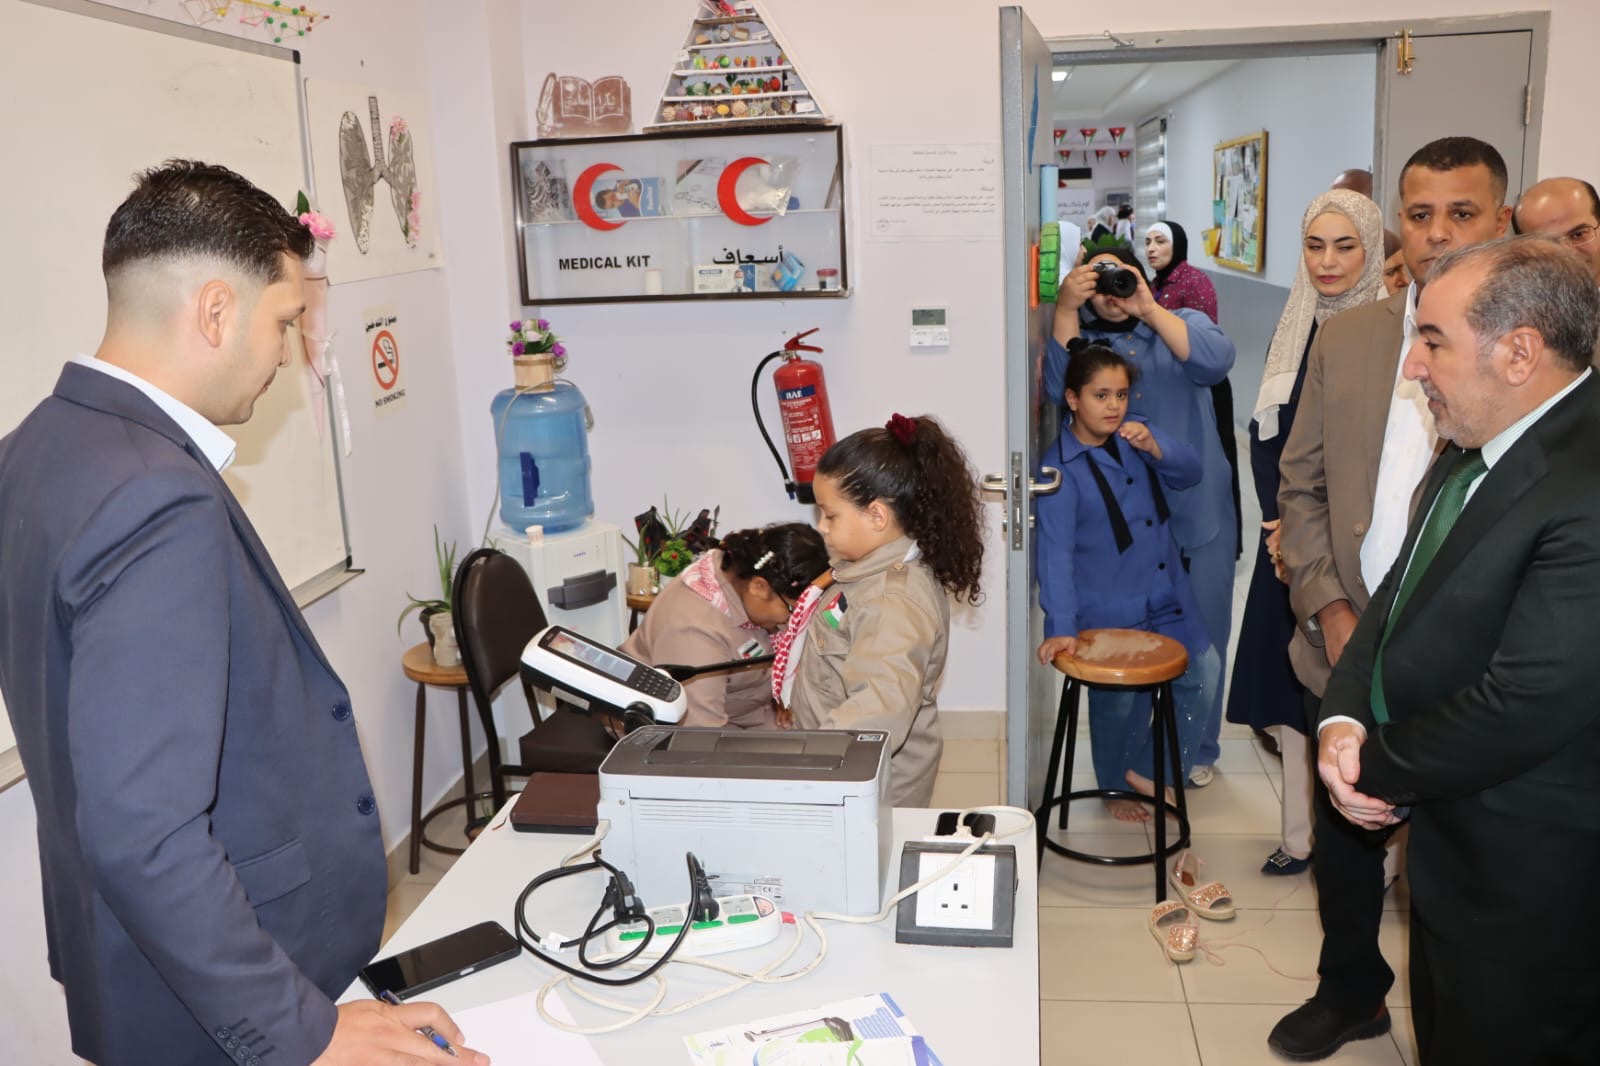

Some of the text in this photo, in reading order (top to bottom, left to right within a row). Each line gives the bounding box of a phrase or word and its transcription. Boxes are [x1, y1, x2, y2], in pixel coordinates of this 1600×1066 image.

[558, 255, 651, 271] MEDICAL KIT
[712, 244, 784, 265] أسعاف
